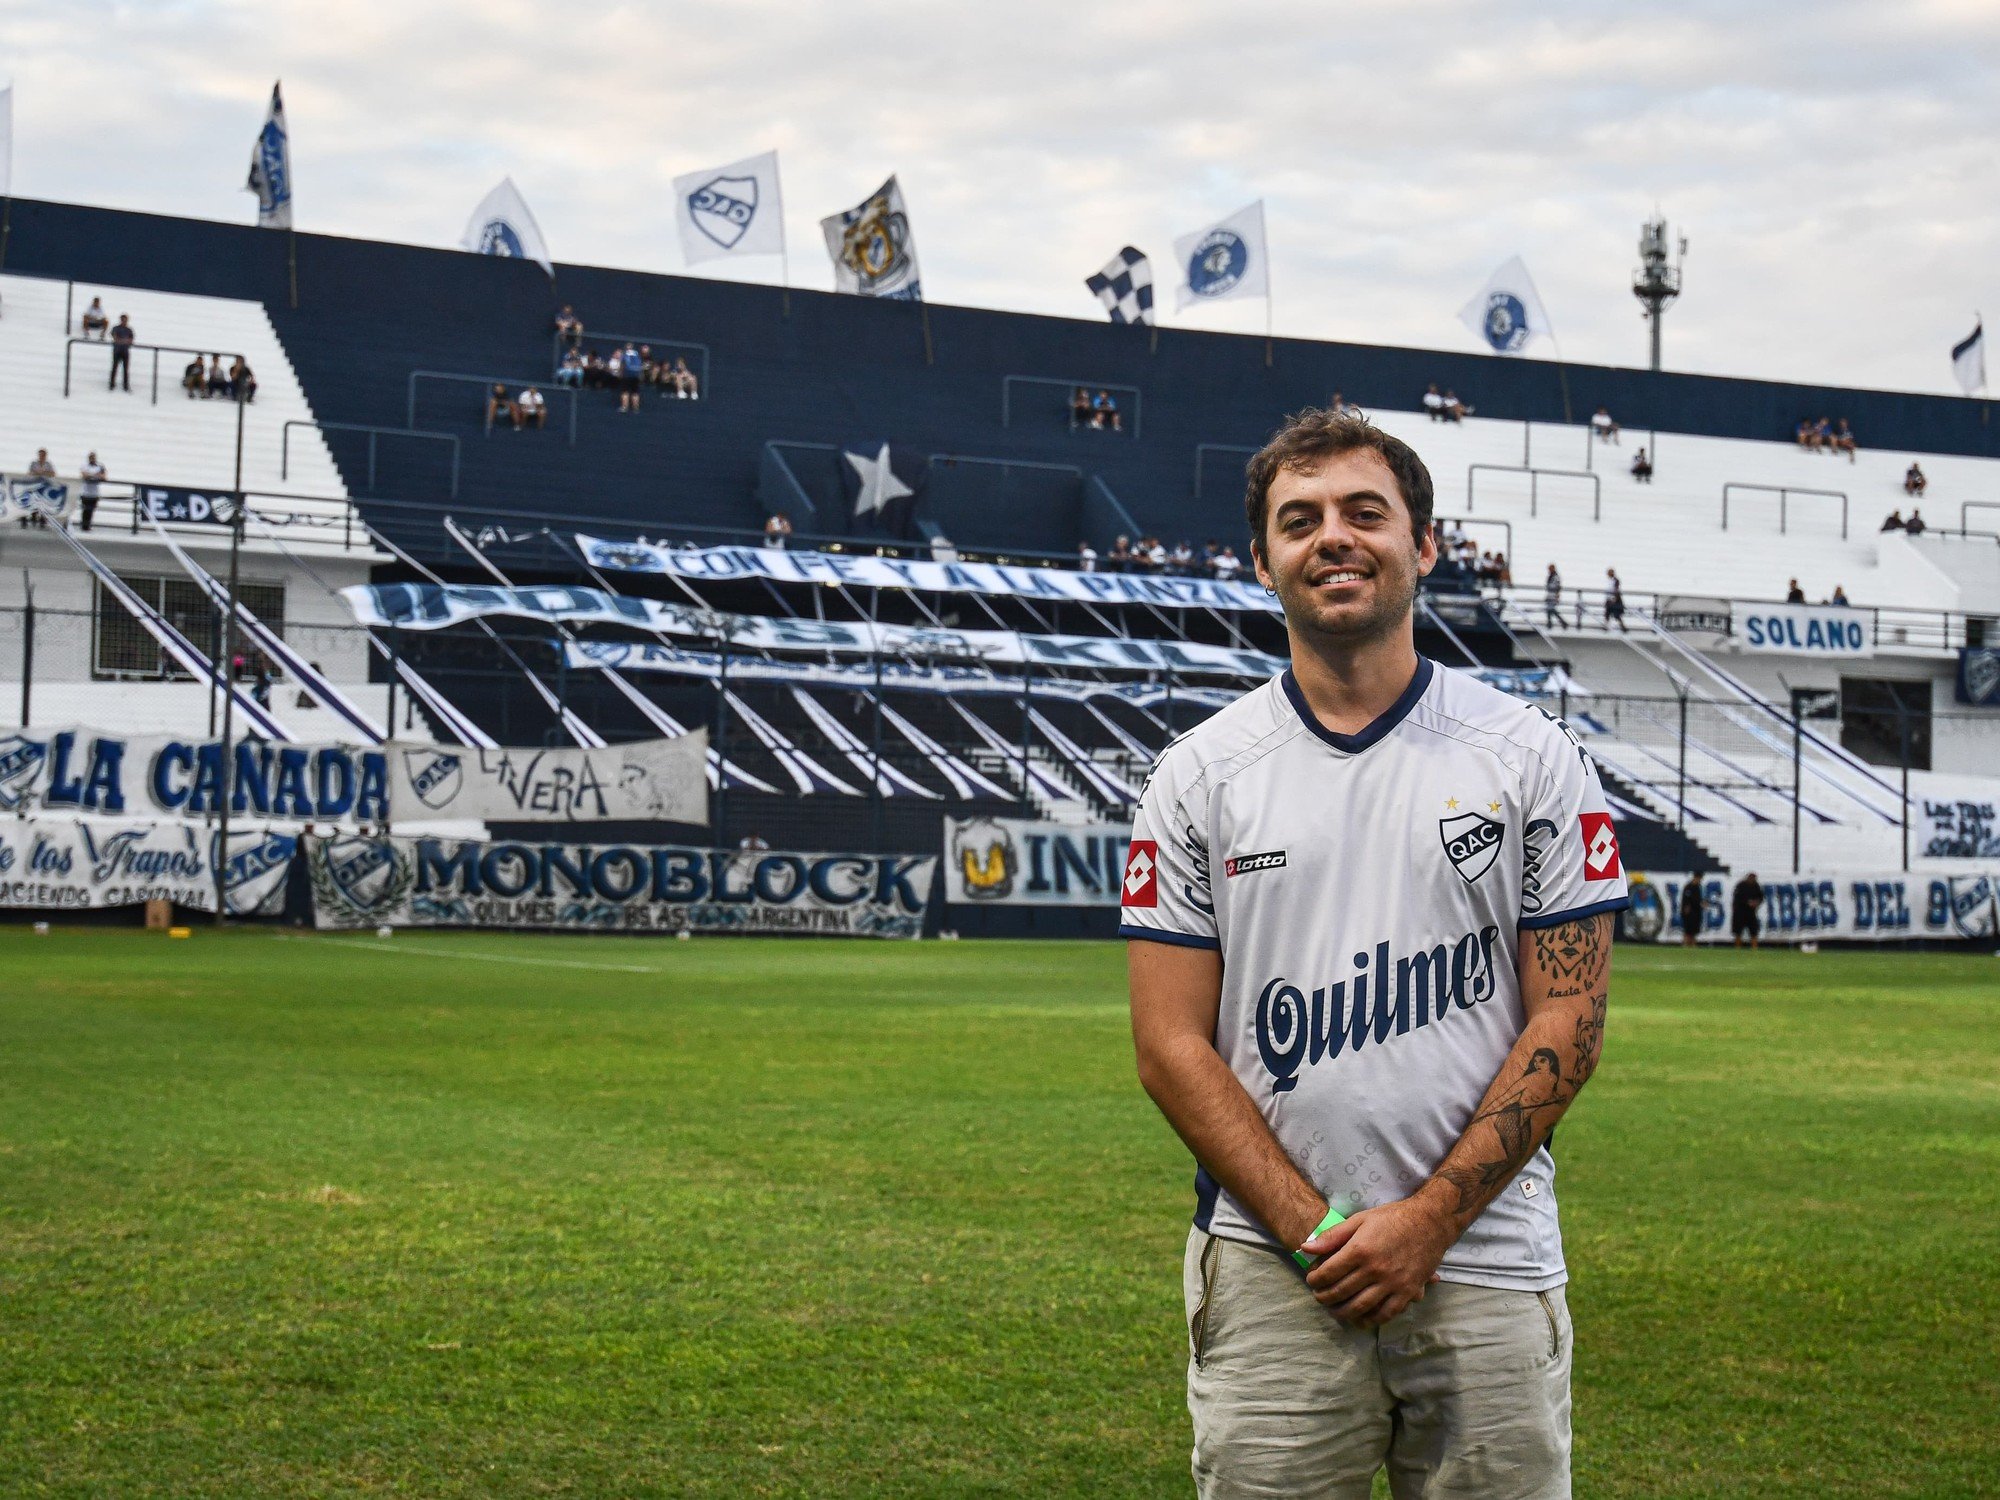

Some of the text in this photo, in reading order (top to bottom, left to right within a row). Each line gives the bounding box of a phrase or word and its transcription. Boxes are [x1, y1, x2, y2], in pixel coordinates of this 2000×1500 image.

[670, 549, 771, 577] CON
[788, 554, 873, 583] FE
[1746, 616, 1862, 649] SOLANO
[46, 731, 125, 811] LA
[507, 750, 609, 821] VERA
[32, 839, 73, 872] los
[1449, 823, 1498, 861] QAC
[411, 839, 923, 913] MONOBLOCK
[1236, 855, 1285, 873] lotto
[750, 907, 849, 931] ARGENTINA
[1665, 880, 1725, 929] LS
[1759, 881, 1839, 929] IBES
[1854, 881, 1910, 929] DEL
[1546, 985, 1582, 998] hasta
[1256, 925, 1499, 1095] Quilmes
